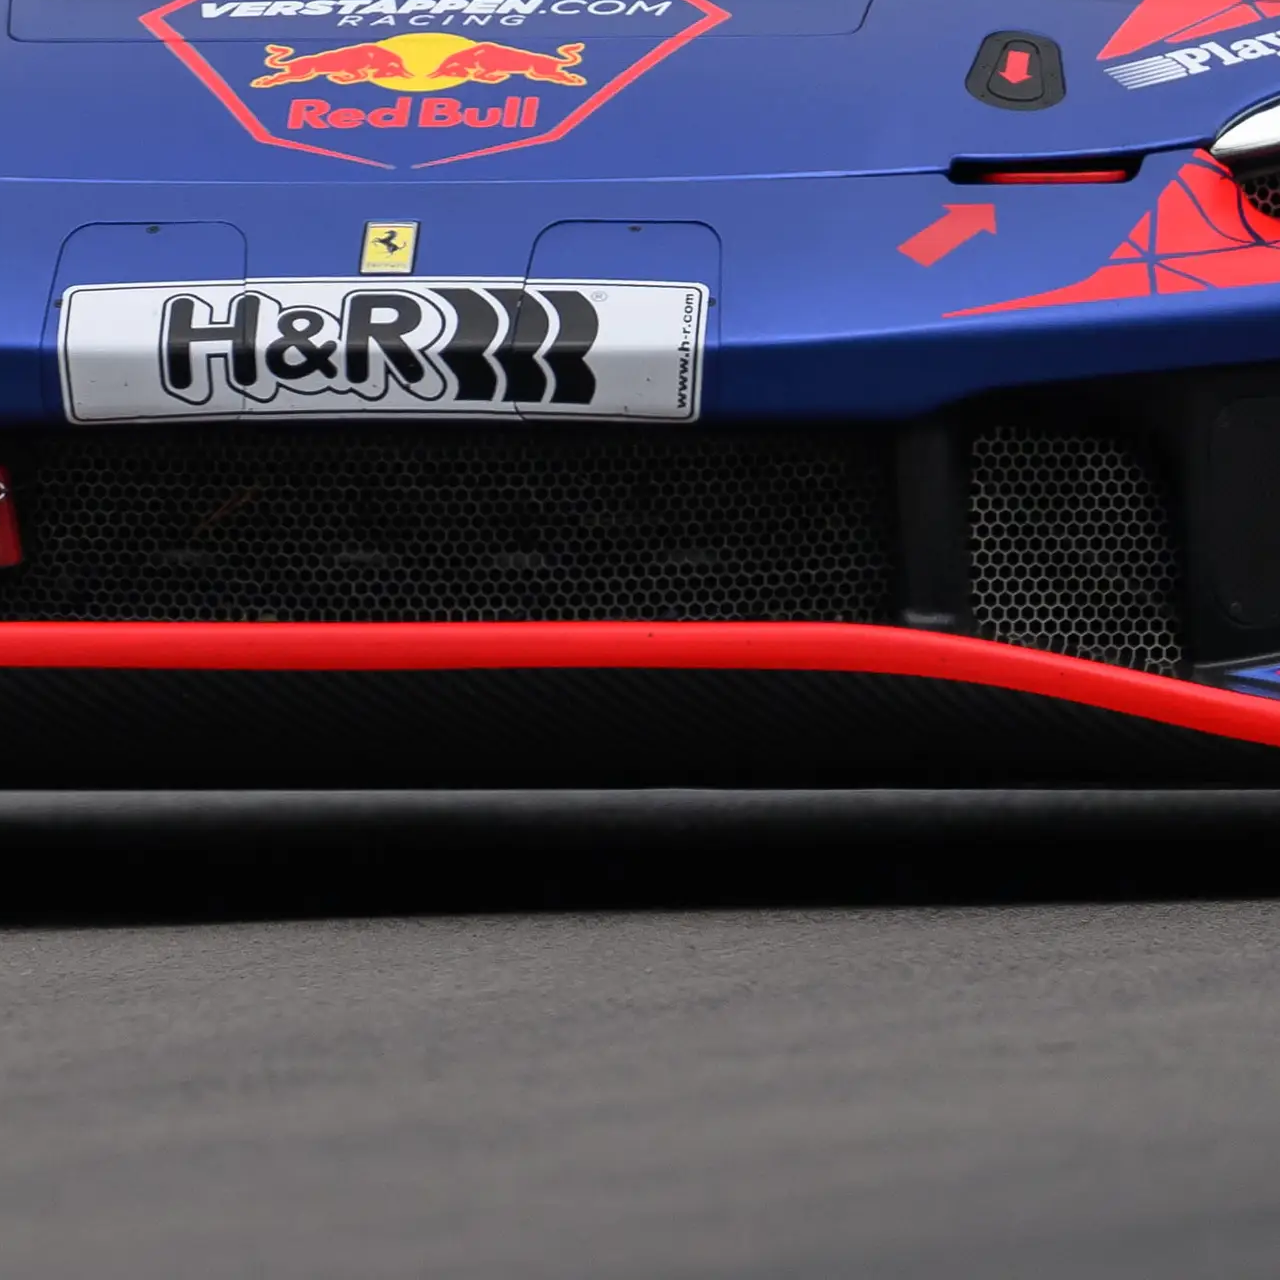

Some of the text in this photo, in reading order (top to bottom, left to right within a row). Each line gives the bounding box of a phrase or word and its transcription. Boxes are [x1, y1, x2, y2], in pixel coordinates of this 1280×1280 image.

[337, 14, 527, 27] RACING
[287, 96, 540, 129] Red Bull
[161, 289, 446, 404] H&R
[677, 293, 695, 410] www.h-r.com
